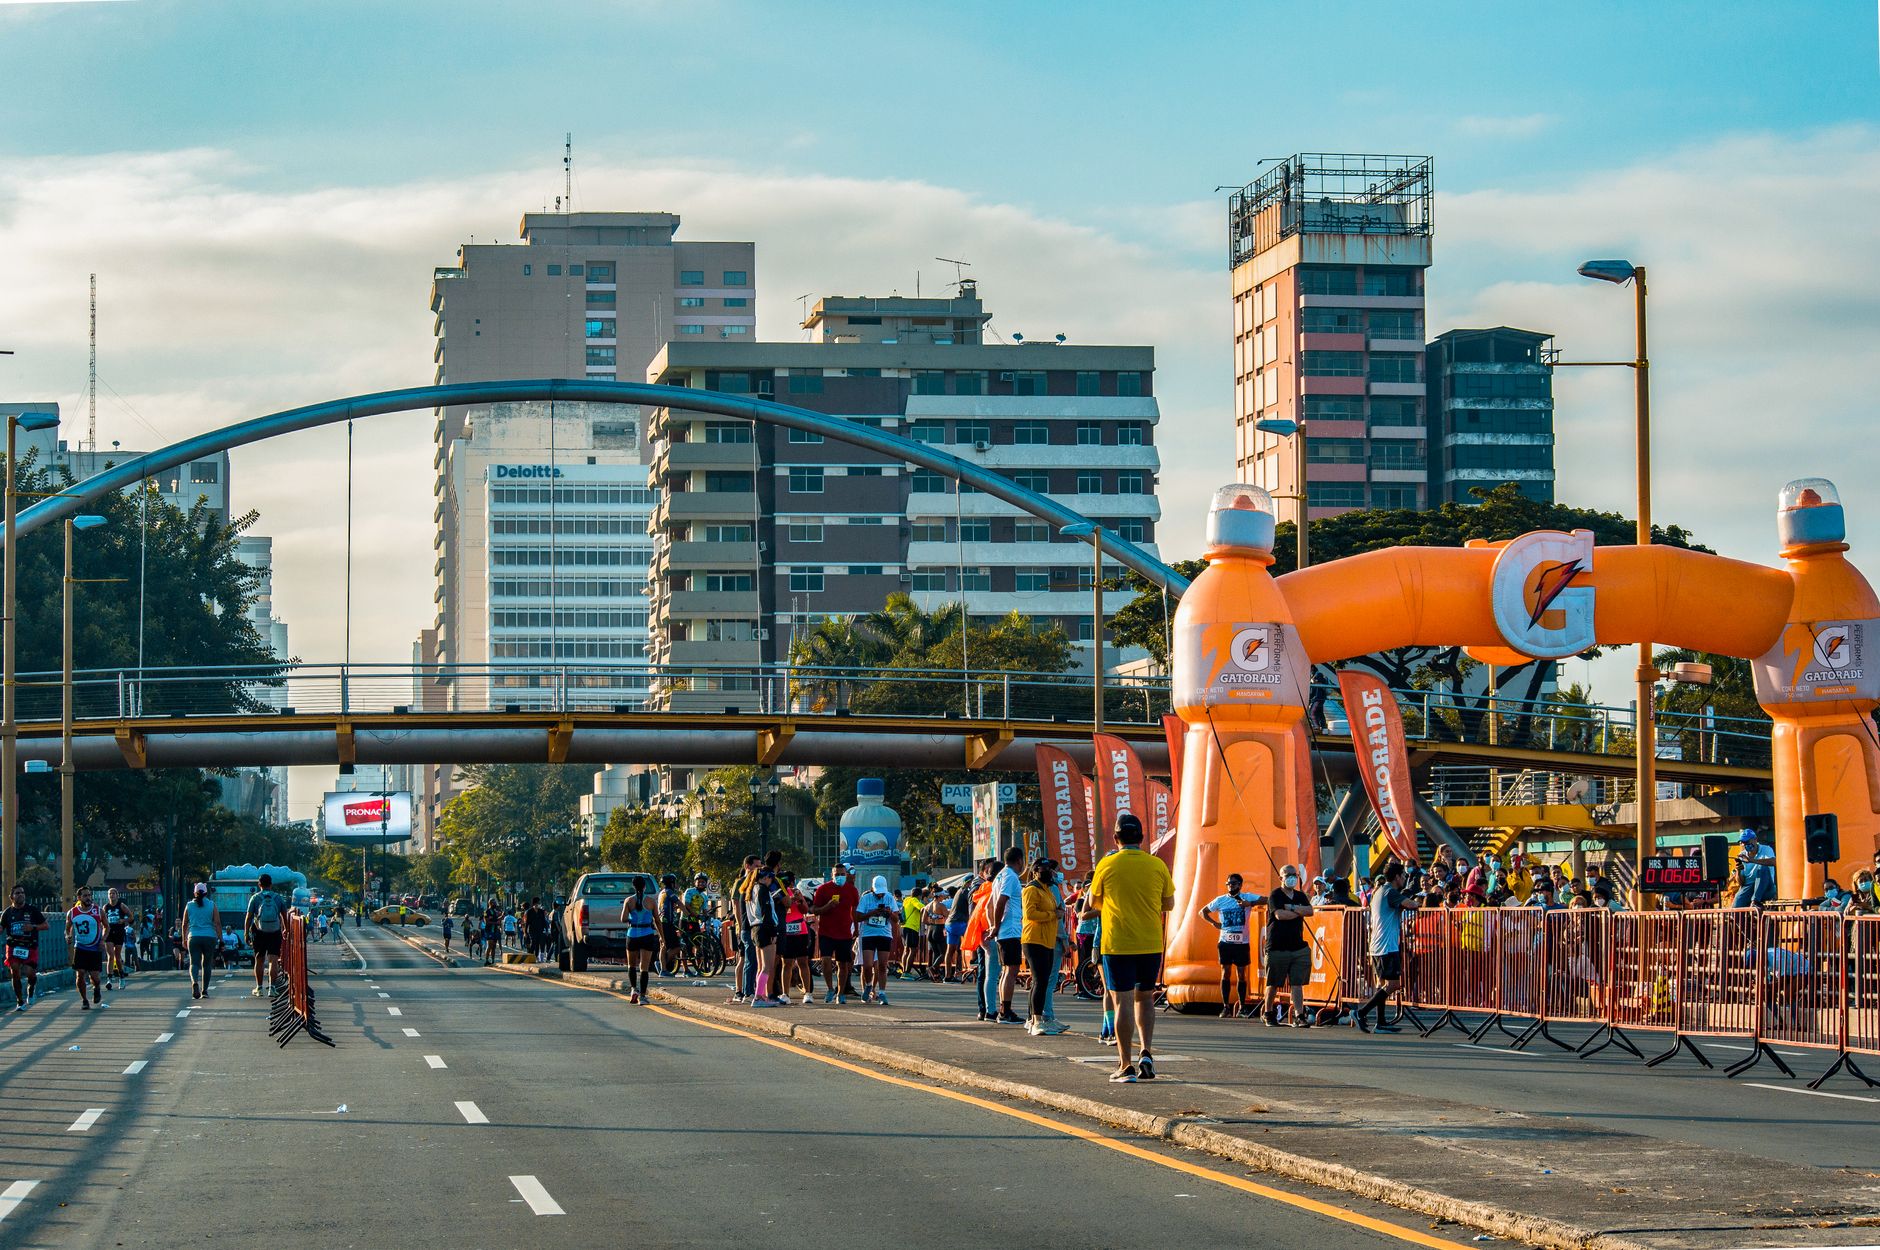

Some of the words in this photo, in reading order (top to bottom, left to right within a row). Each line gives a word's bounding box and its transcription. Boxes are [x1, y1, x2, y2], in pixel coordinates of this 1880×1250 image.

[1230, 628, 1269, 672] G
[1220, 673, 1281, 684] GATORADE
[1804, 669, 1863, 682] GATORADE
[1362, 688, 1401, 838] GATORADE
[1053, 760, 1077, 870] GATORADE
[1649, 860, 1663, 868] HRS.
[1667, 859, 1681, 868] MIN.
[1685, 860, 1699, 868] SEG.
